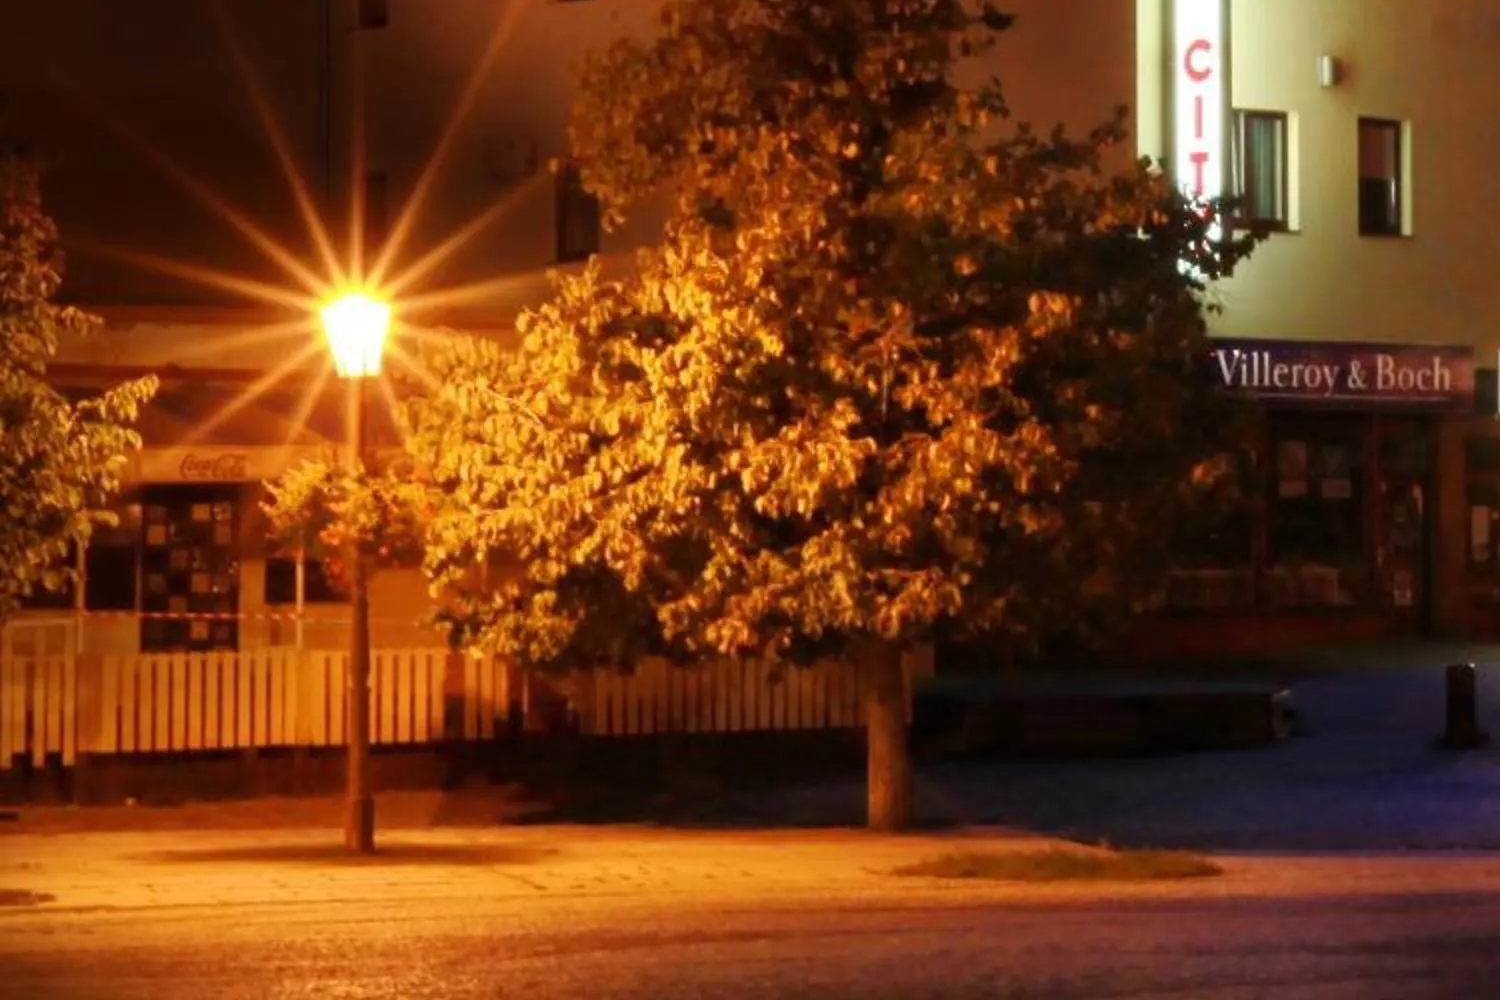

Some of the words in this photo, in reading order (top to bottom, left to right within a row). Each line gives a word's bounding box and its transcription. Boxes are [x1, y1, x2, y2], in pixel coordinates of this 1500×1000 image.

[1216, 349, 1340, 398] Villeroy
[1347, 359, 1368, 391] &
[1376, 353, 1451, 391] Boch
